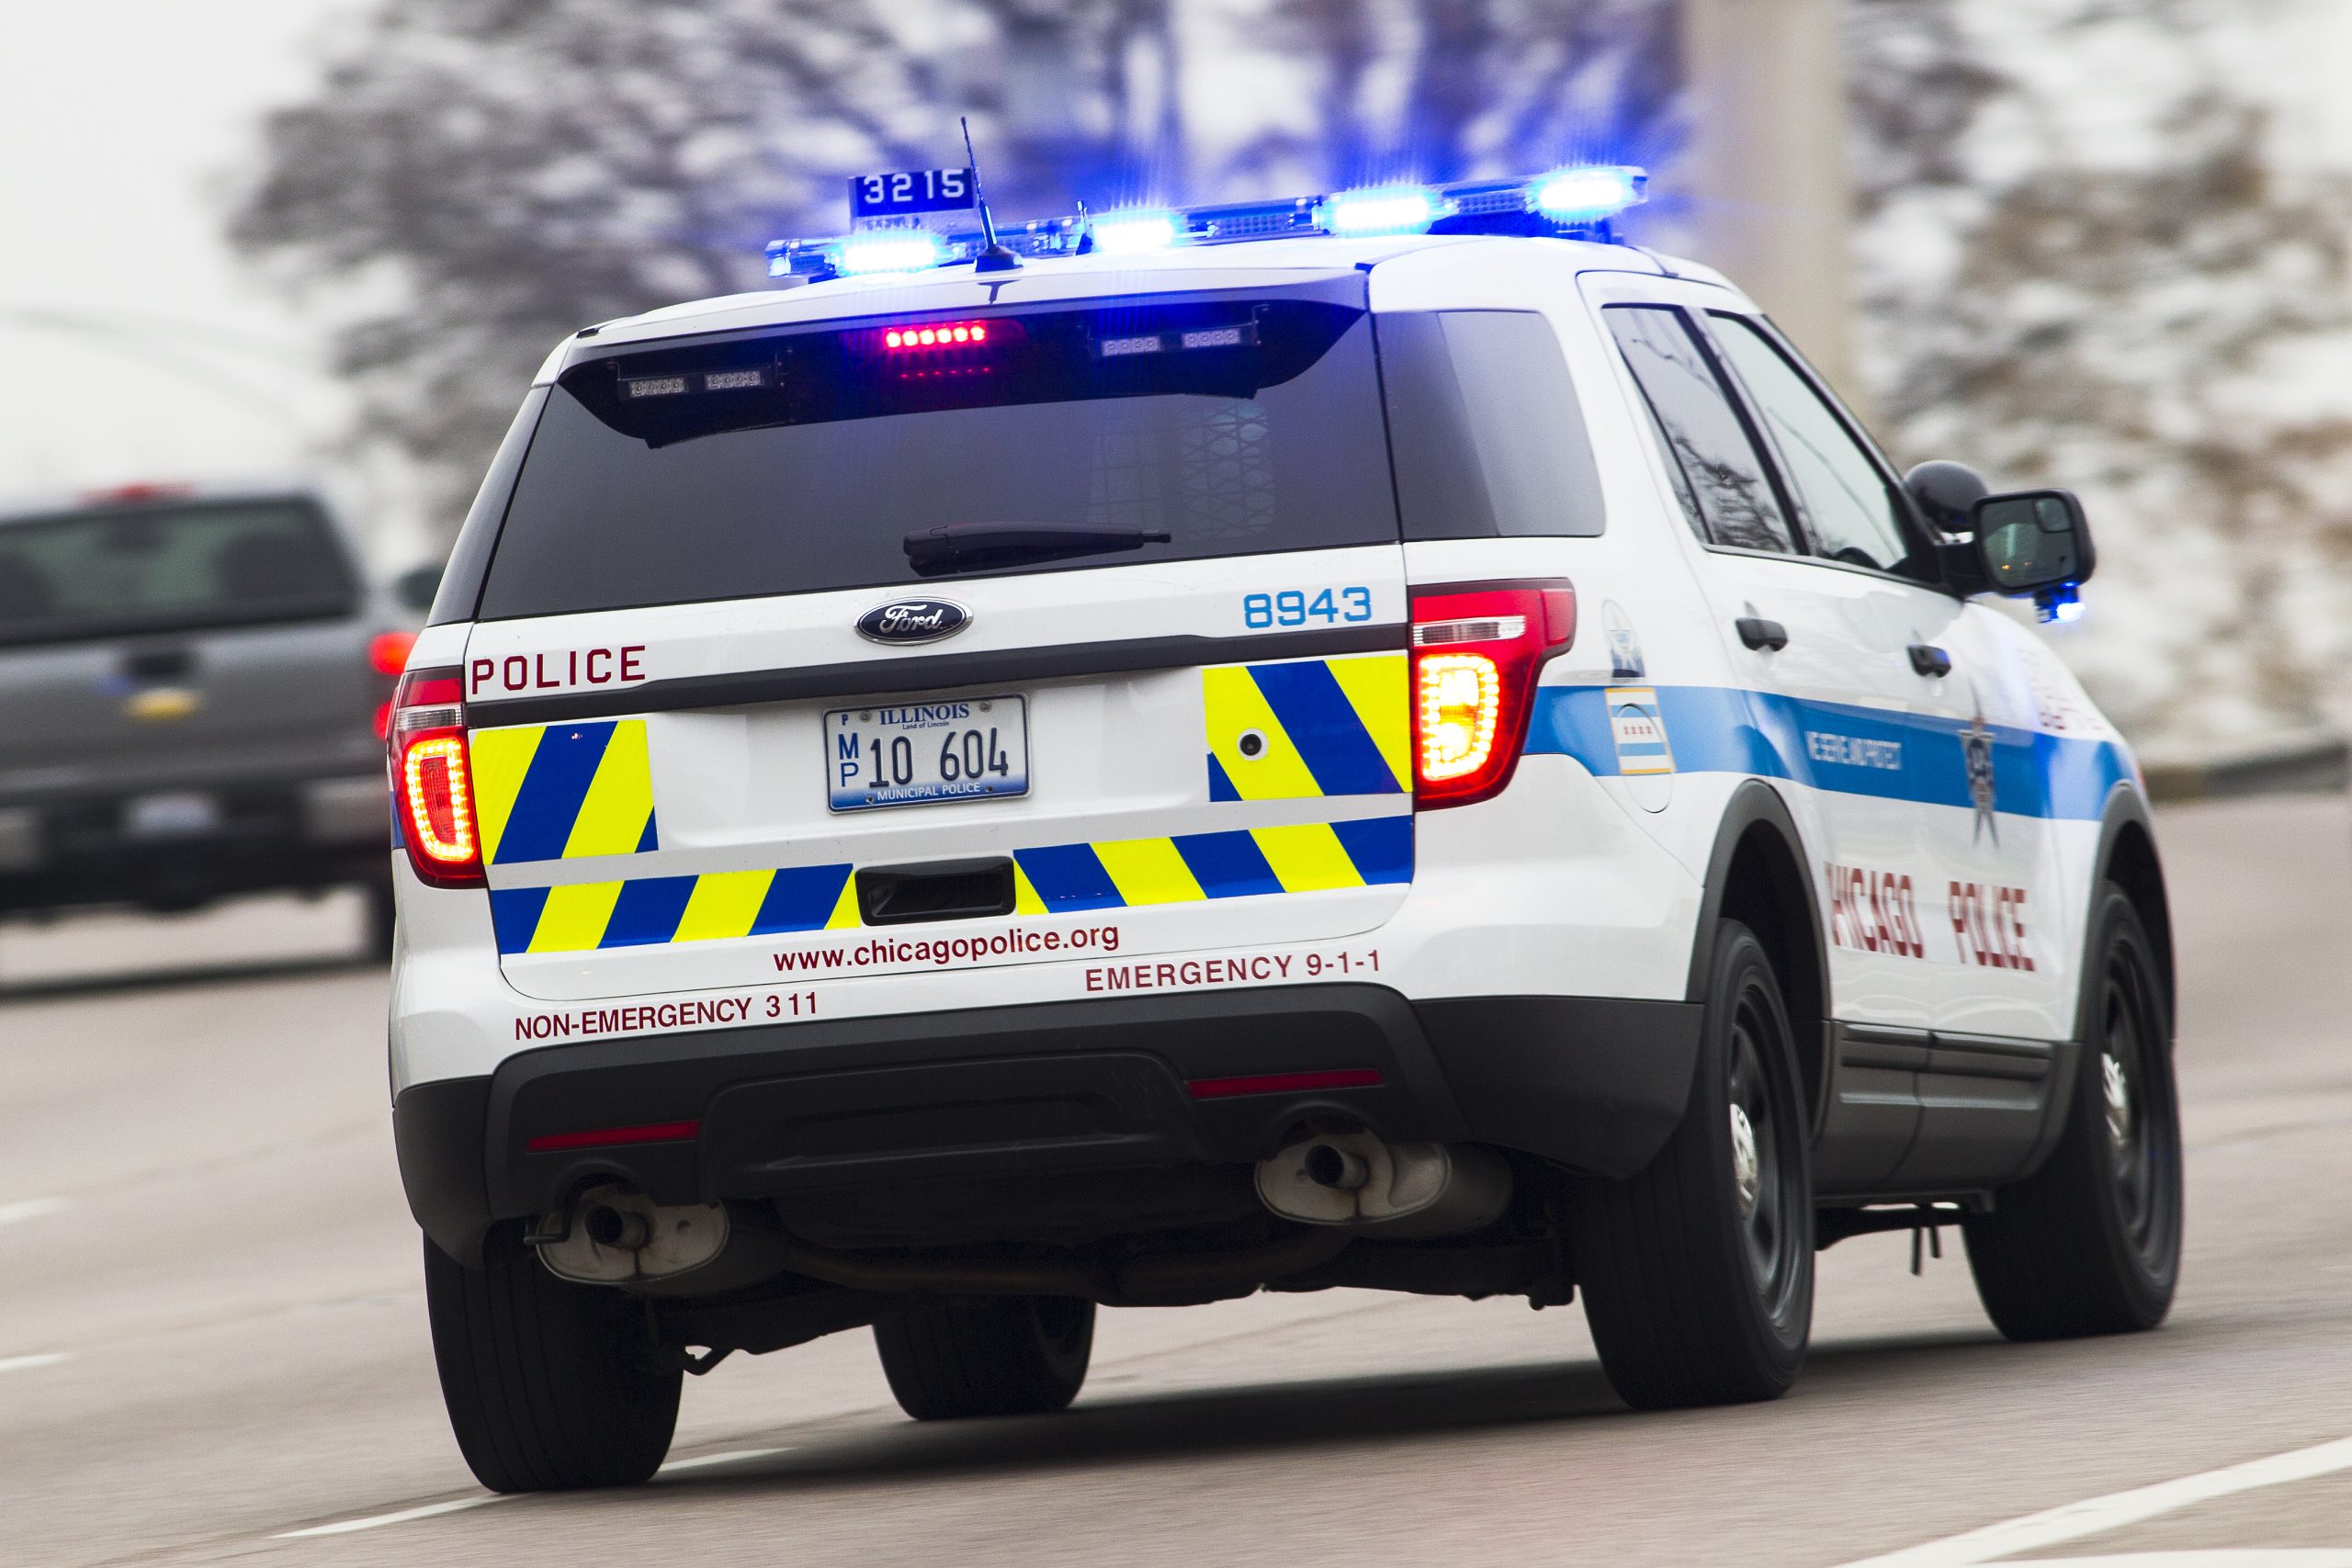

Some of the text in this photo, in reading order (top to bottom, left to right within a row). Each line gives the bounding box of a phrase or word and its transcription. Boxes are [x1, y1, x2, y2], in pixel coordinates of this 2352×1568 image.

[863, 168, 965, 204] 3215
[879, 604, 944, 634] Ford
[1243, 586, 1372, 629] 8943
[471, 645, 646, 695] POLICE
[842, 714, 849, 726] P
[879, 703, 970, 726] ILLINOIS
[869, 728, 1009, 788] 10 604
[877, 783, 980, 801] MUNICIPAL POLICE
[774, 926, 1120, 971] www.chicagopolice.org
[1085, 950, 1379, 992] EMERGENCY 9-1-1
[515, 992, 818, 1041] NON-EMERGENCY 311
